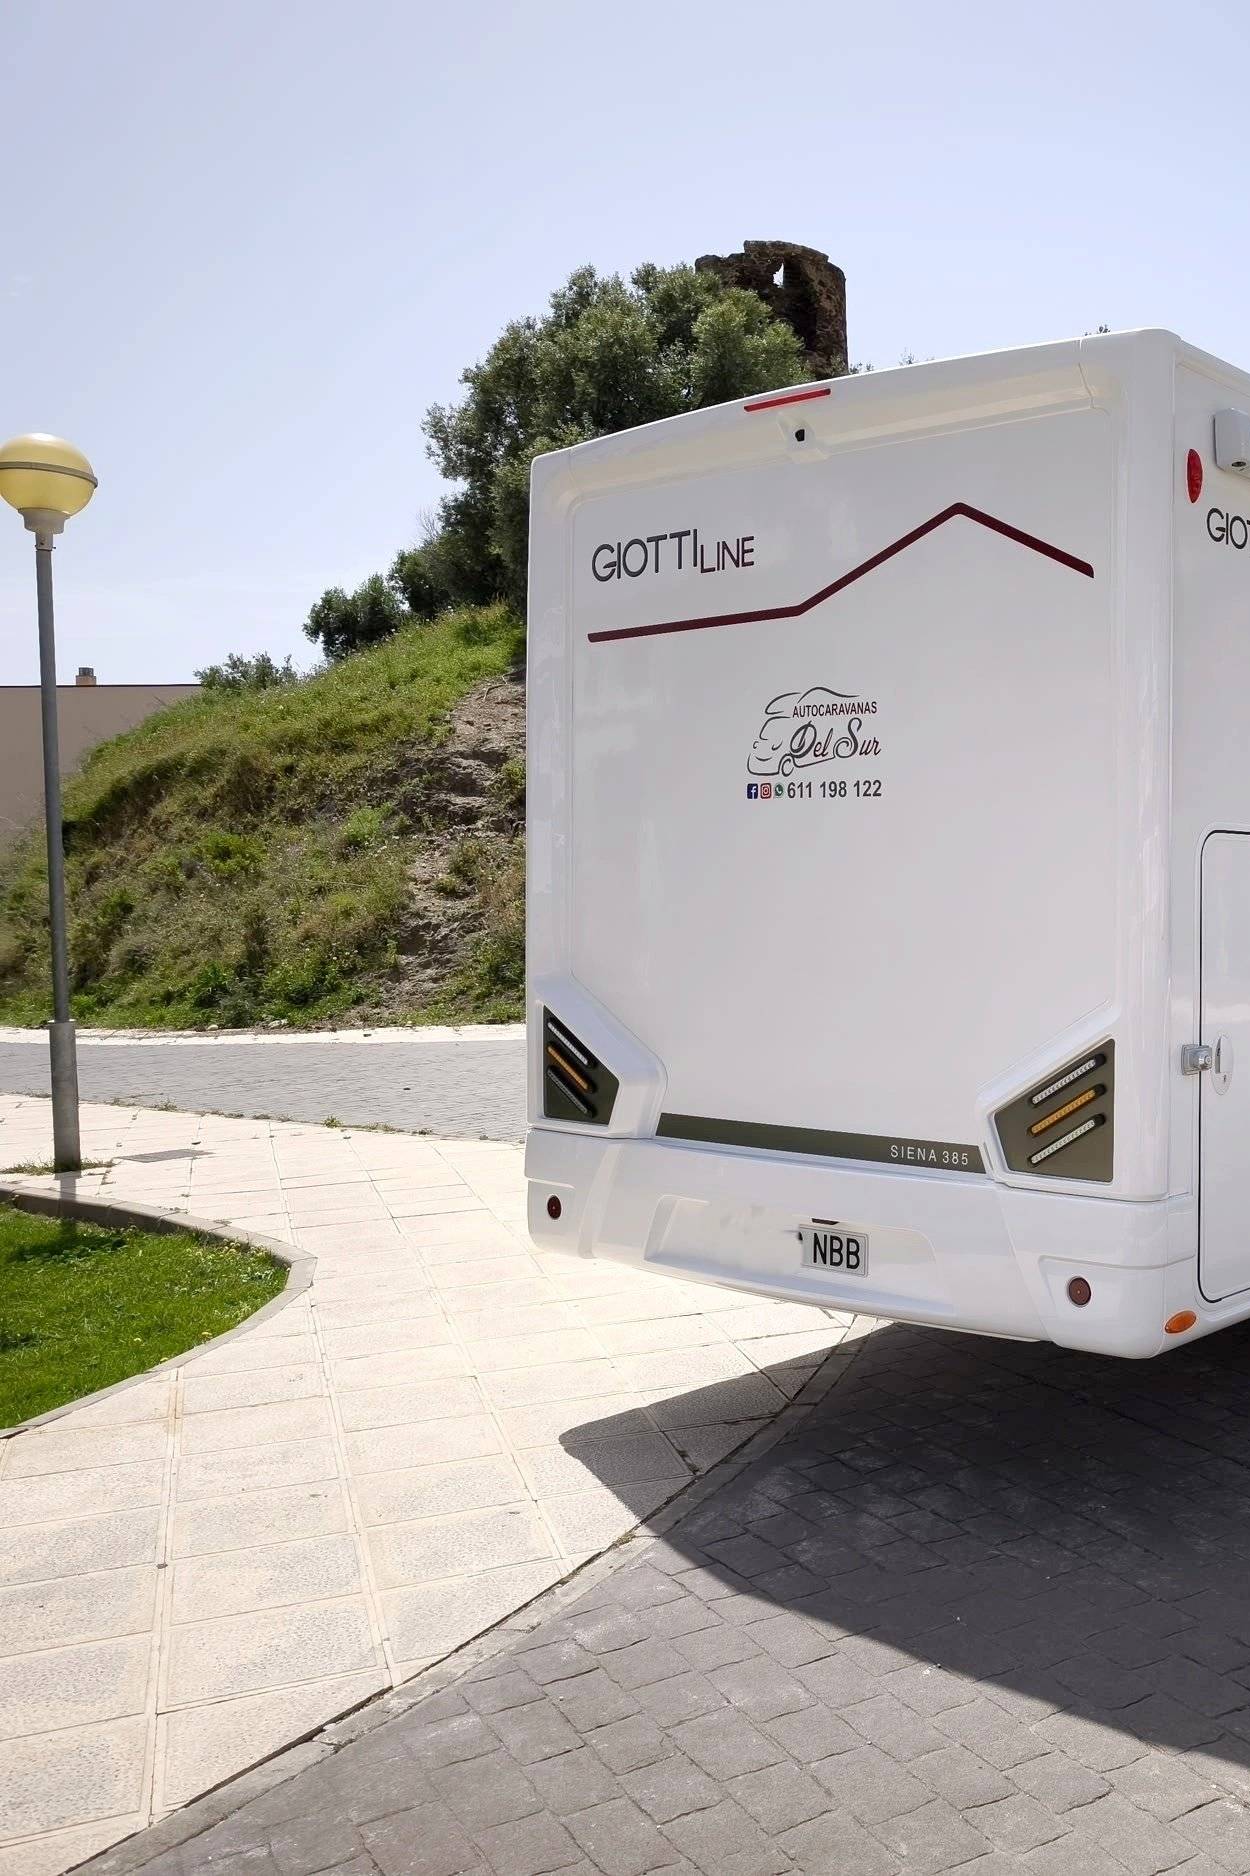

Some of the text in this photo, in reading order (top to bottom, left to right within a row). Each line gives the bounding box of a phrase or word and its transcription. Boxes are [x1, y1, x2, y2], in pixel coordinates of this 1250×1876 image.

[792, 701, 878, 718] AUTOCARAVANAS
[790, 717, 881, 758] Del Sur
[787, 780, 882, 799] 611 198 122
[890, 1145, 969, 1165] SIENA 385
[813, 1232, 861, 1270] NBB
